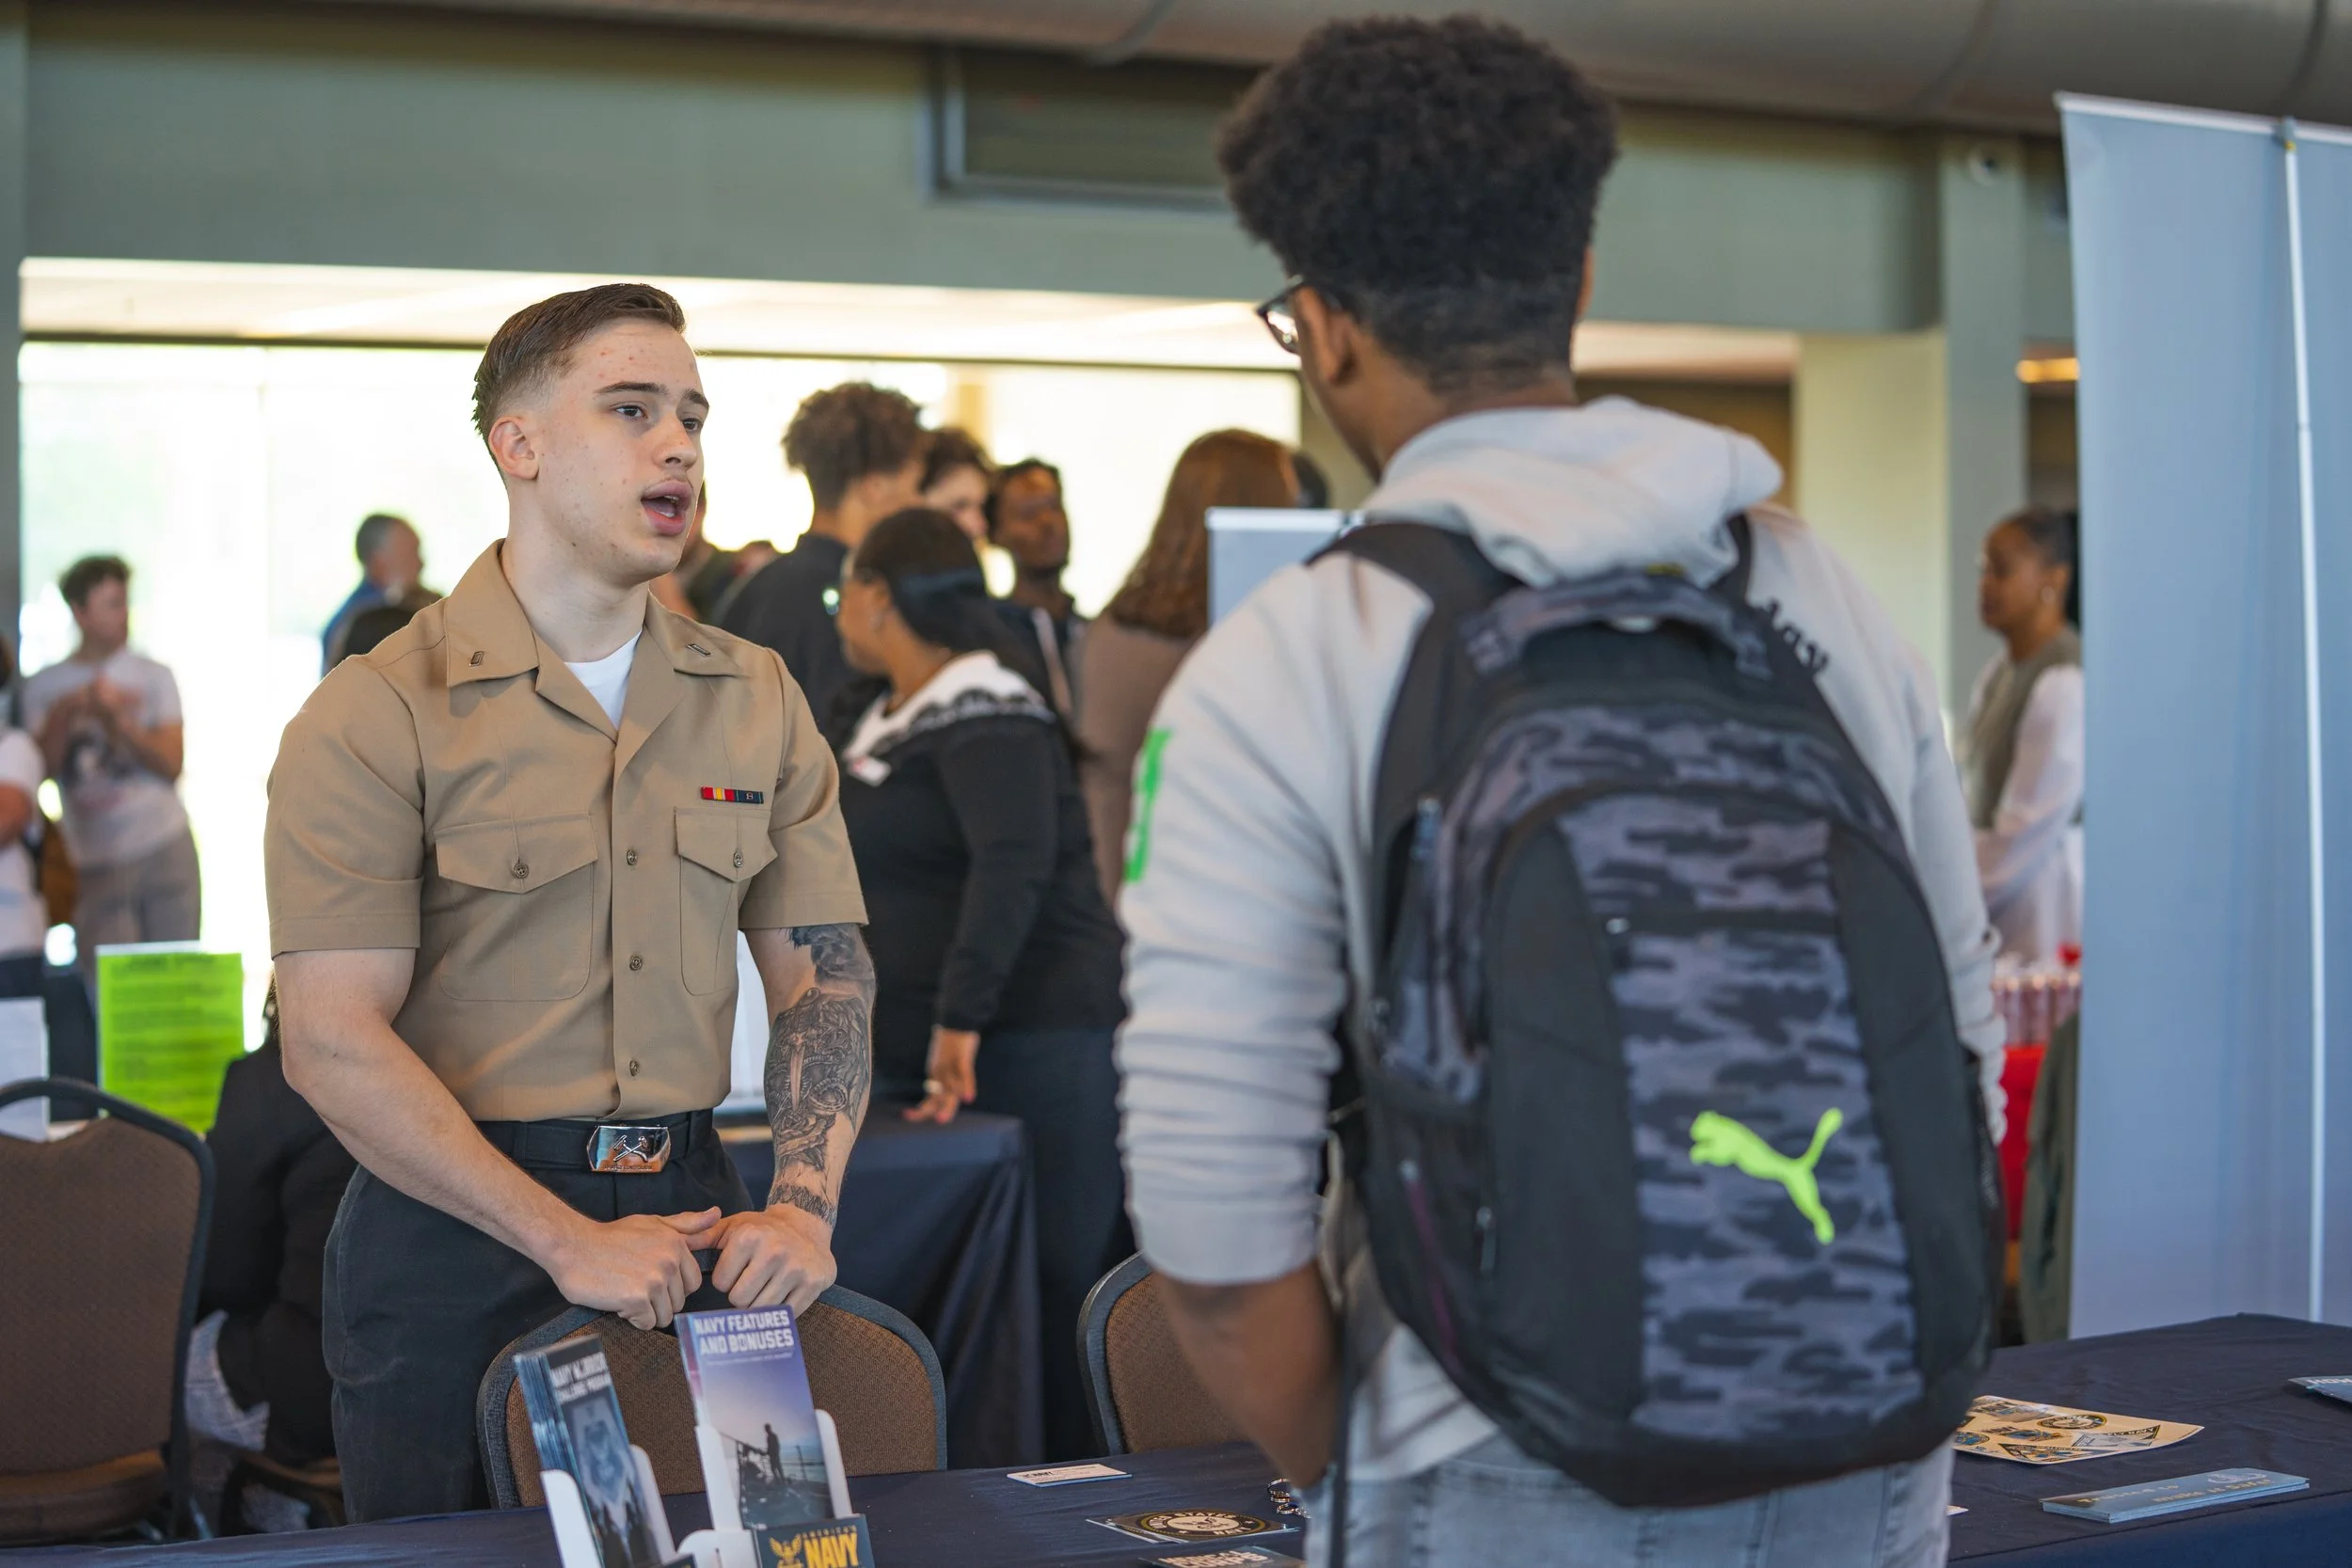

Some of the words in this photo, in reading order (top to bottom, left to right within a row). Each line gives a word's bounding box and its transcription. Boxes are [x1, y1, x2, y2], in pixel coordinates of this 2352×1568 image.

[692, 1316, 725, 1336] NAVY
[726, 1309, 790, 1333] FEATURES
[699, 1335, 728, 1356] AND
[728, 1328, 795, 1354] BONUSES
[803, 1532, 860, 1568] NAVY
